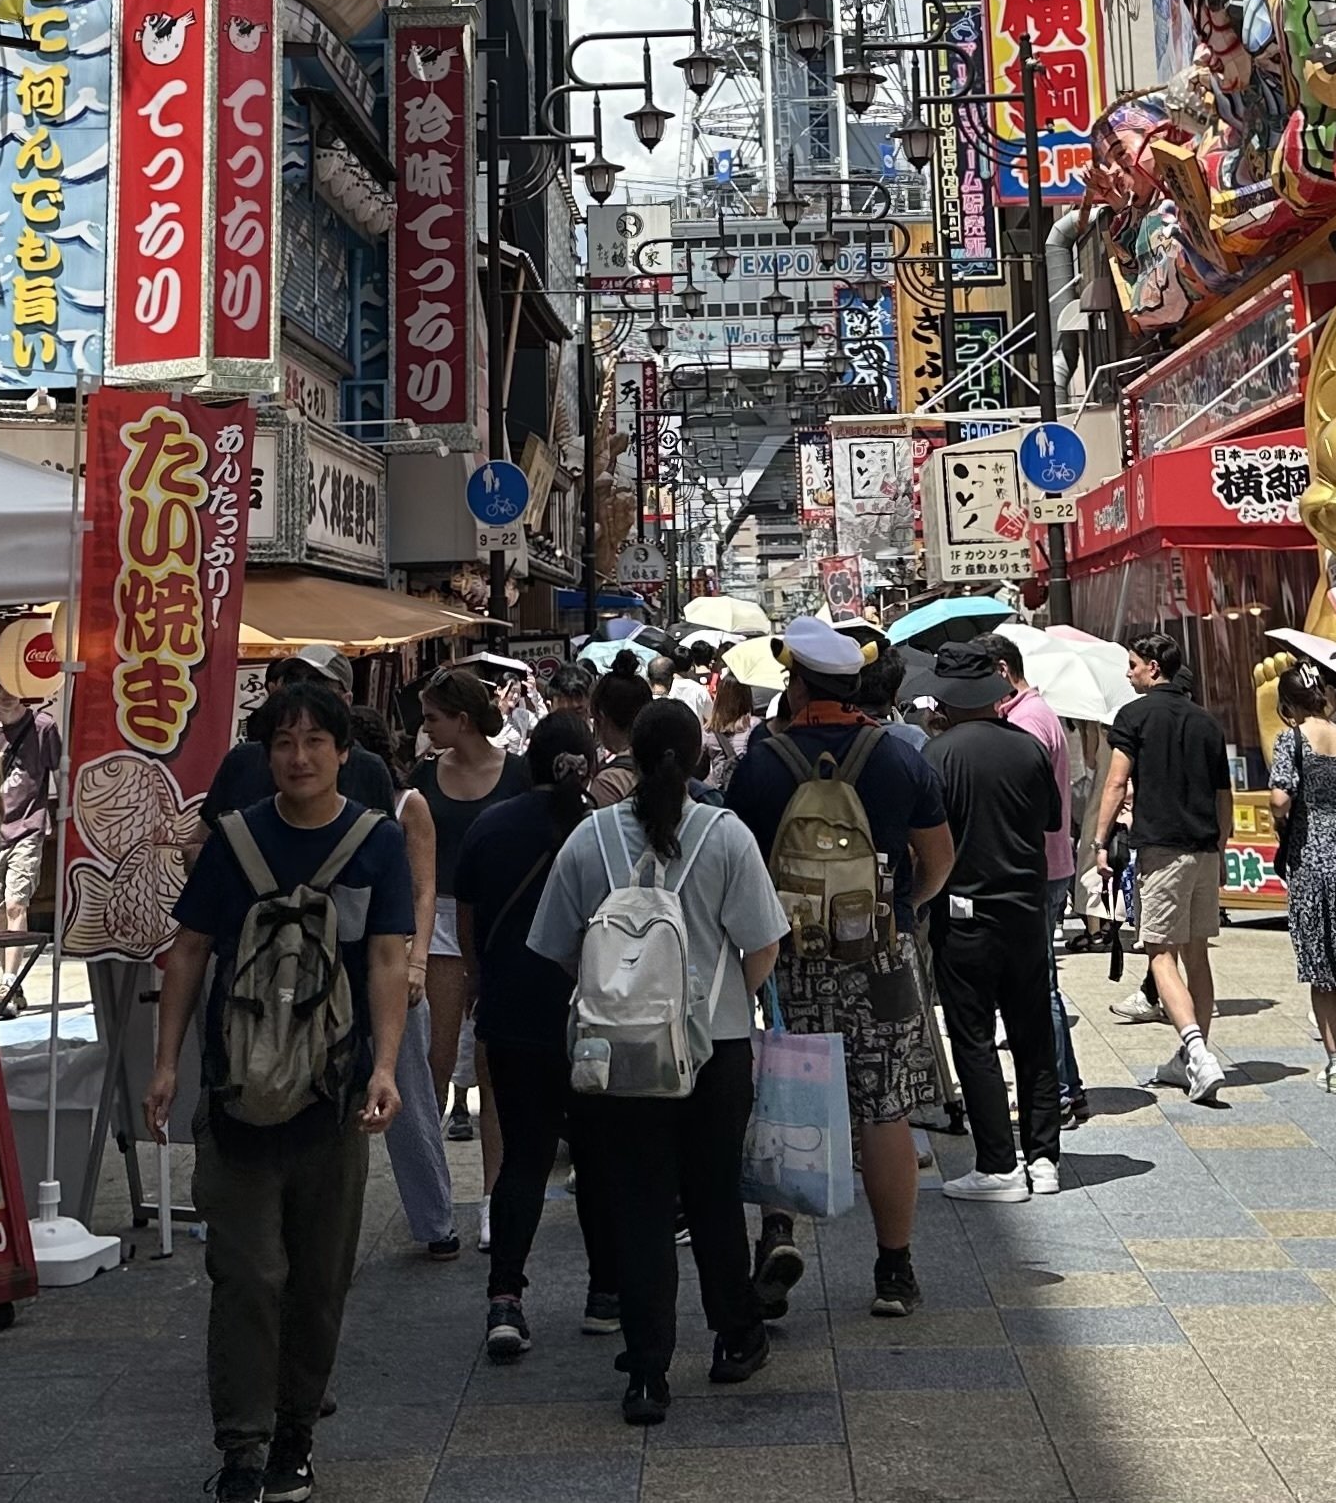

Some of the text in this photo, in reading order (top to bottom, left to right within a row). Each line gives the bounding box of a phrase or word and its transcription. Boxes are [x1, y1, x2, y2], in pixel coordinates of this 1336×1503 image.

[134, 79, 189, 335] てっちり
[218, 79, 266, 331] てっちり
[400, 94, 458, 413] 珍味てっちり
[740, 252, 813, 276] EXPO
[122, 409, 206, 747] たい焼き
[1213, 448, 1309, 461] 日本一の串か
[1215, 463, 1310, 505] 横綱
